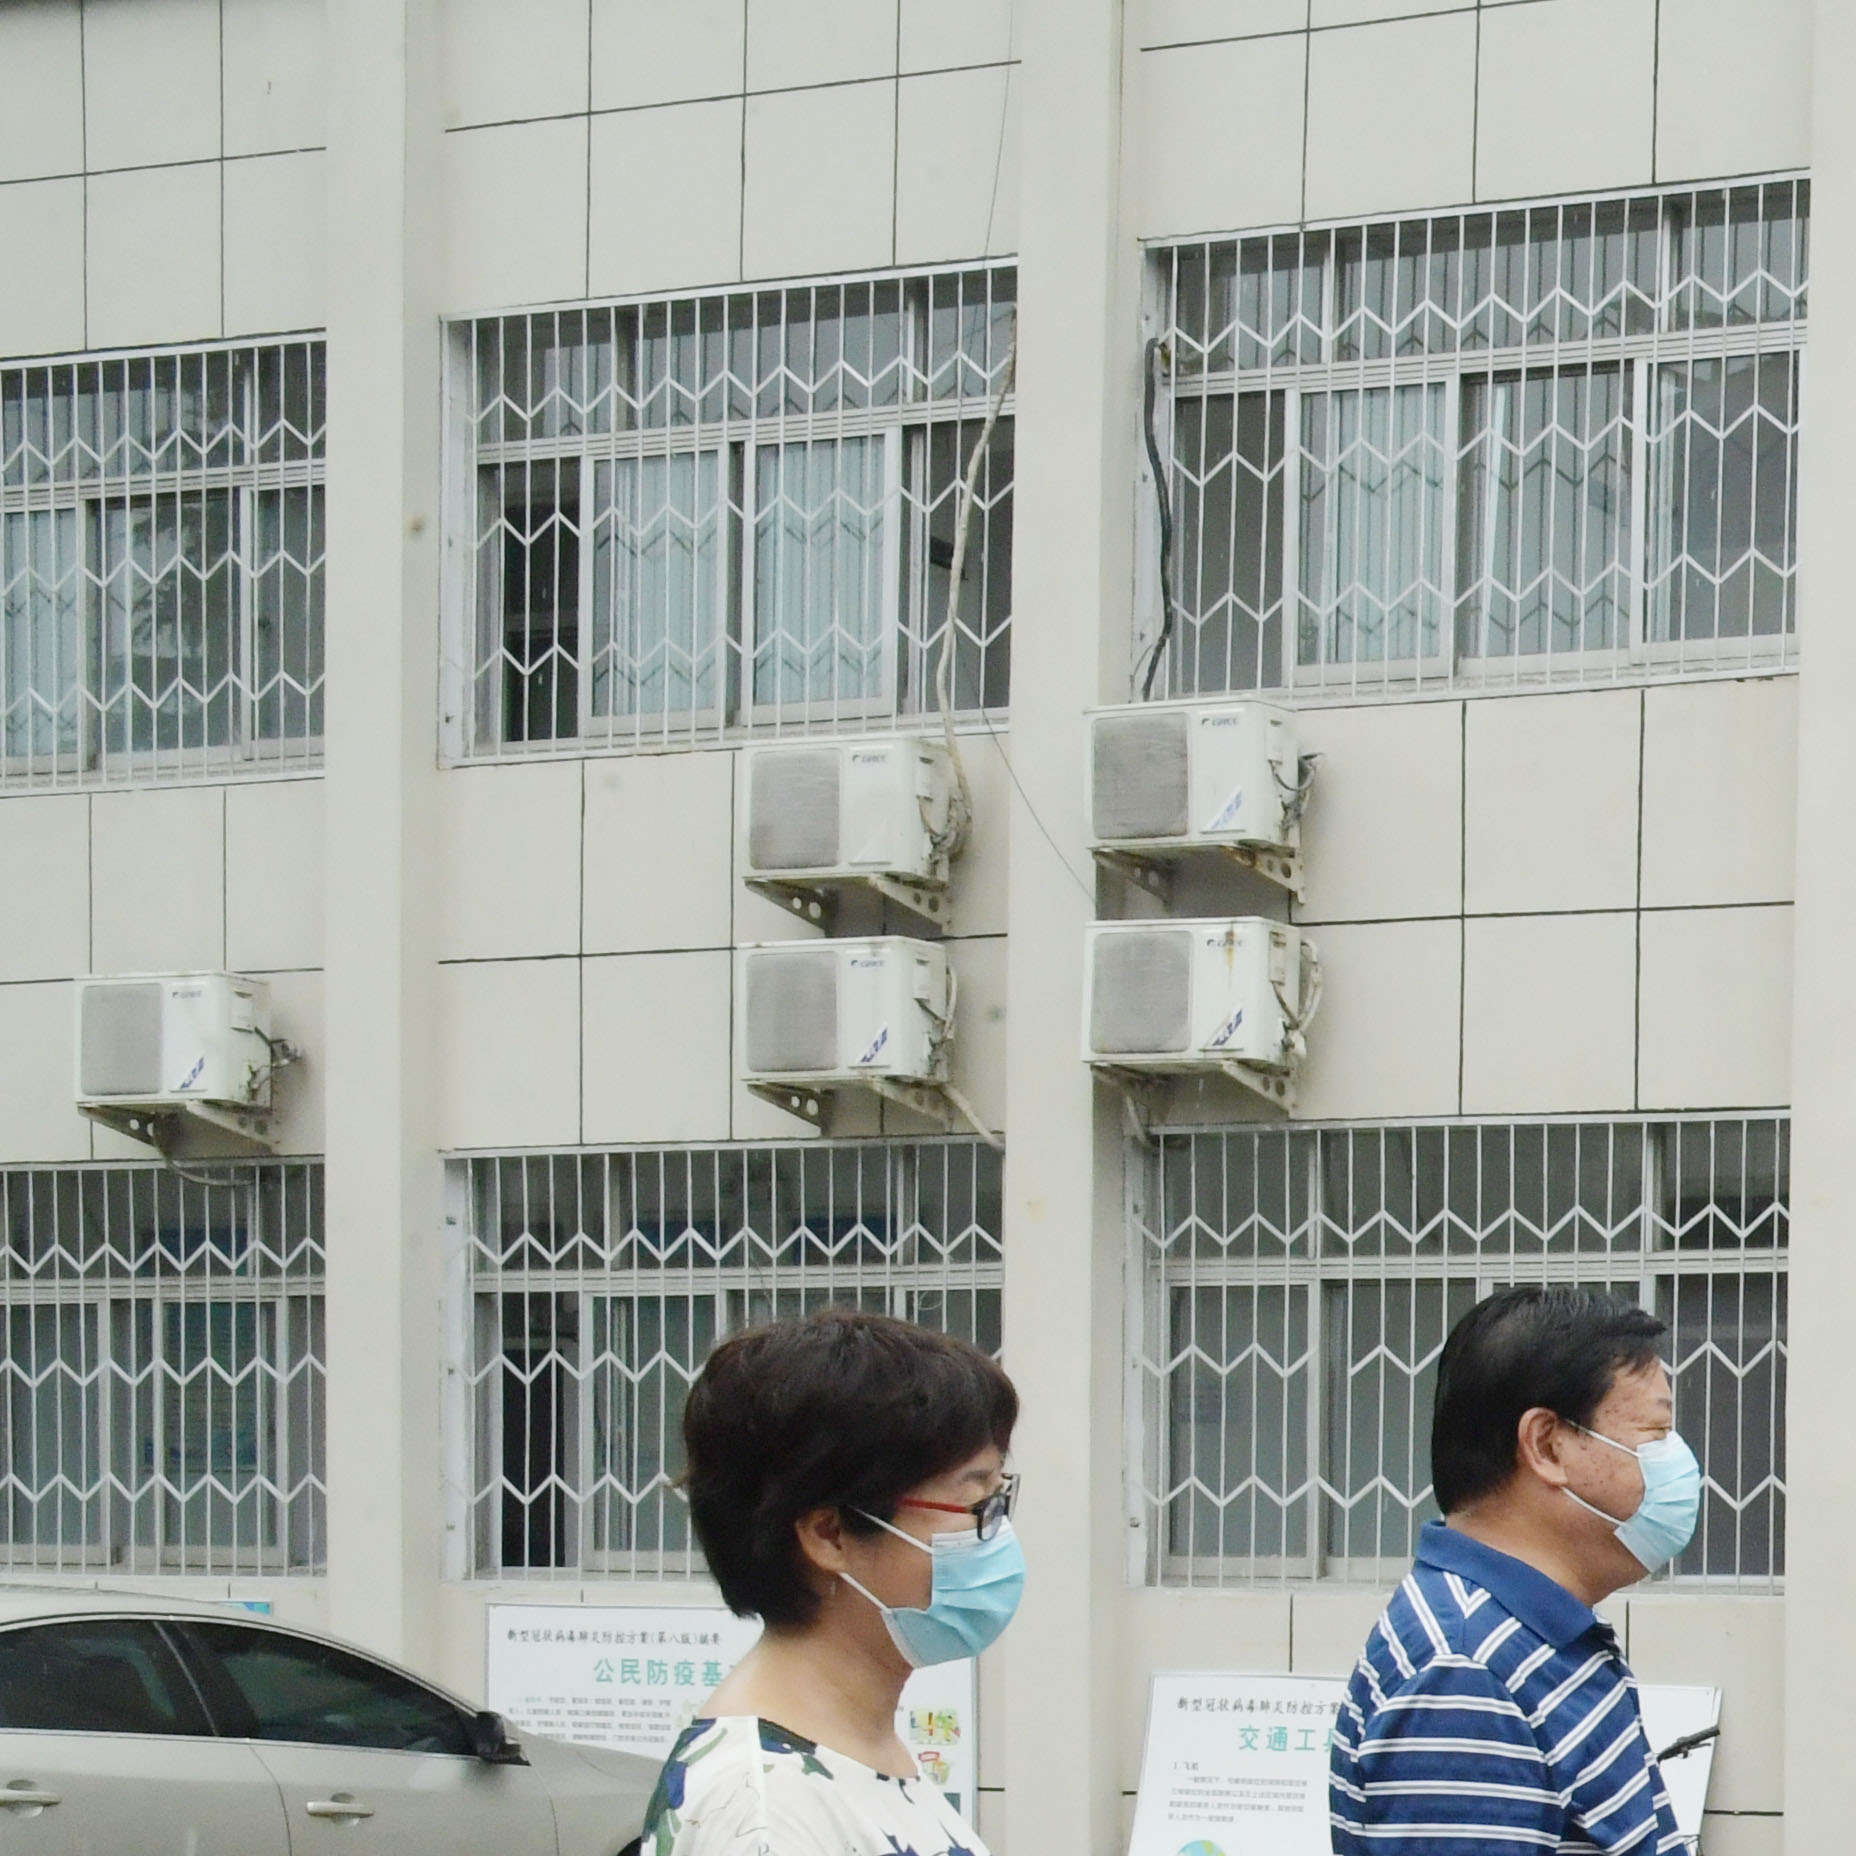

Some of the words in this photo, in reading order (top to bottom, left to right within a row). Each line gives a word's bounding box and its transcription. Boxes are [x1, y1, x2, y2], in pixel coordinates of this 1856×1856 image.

[594, 1657, 735, 1687] 公民防疫基
